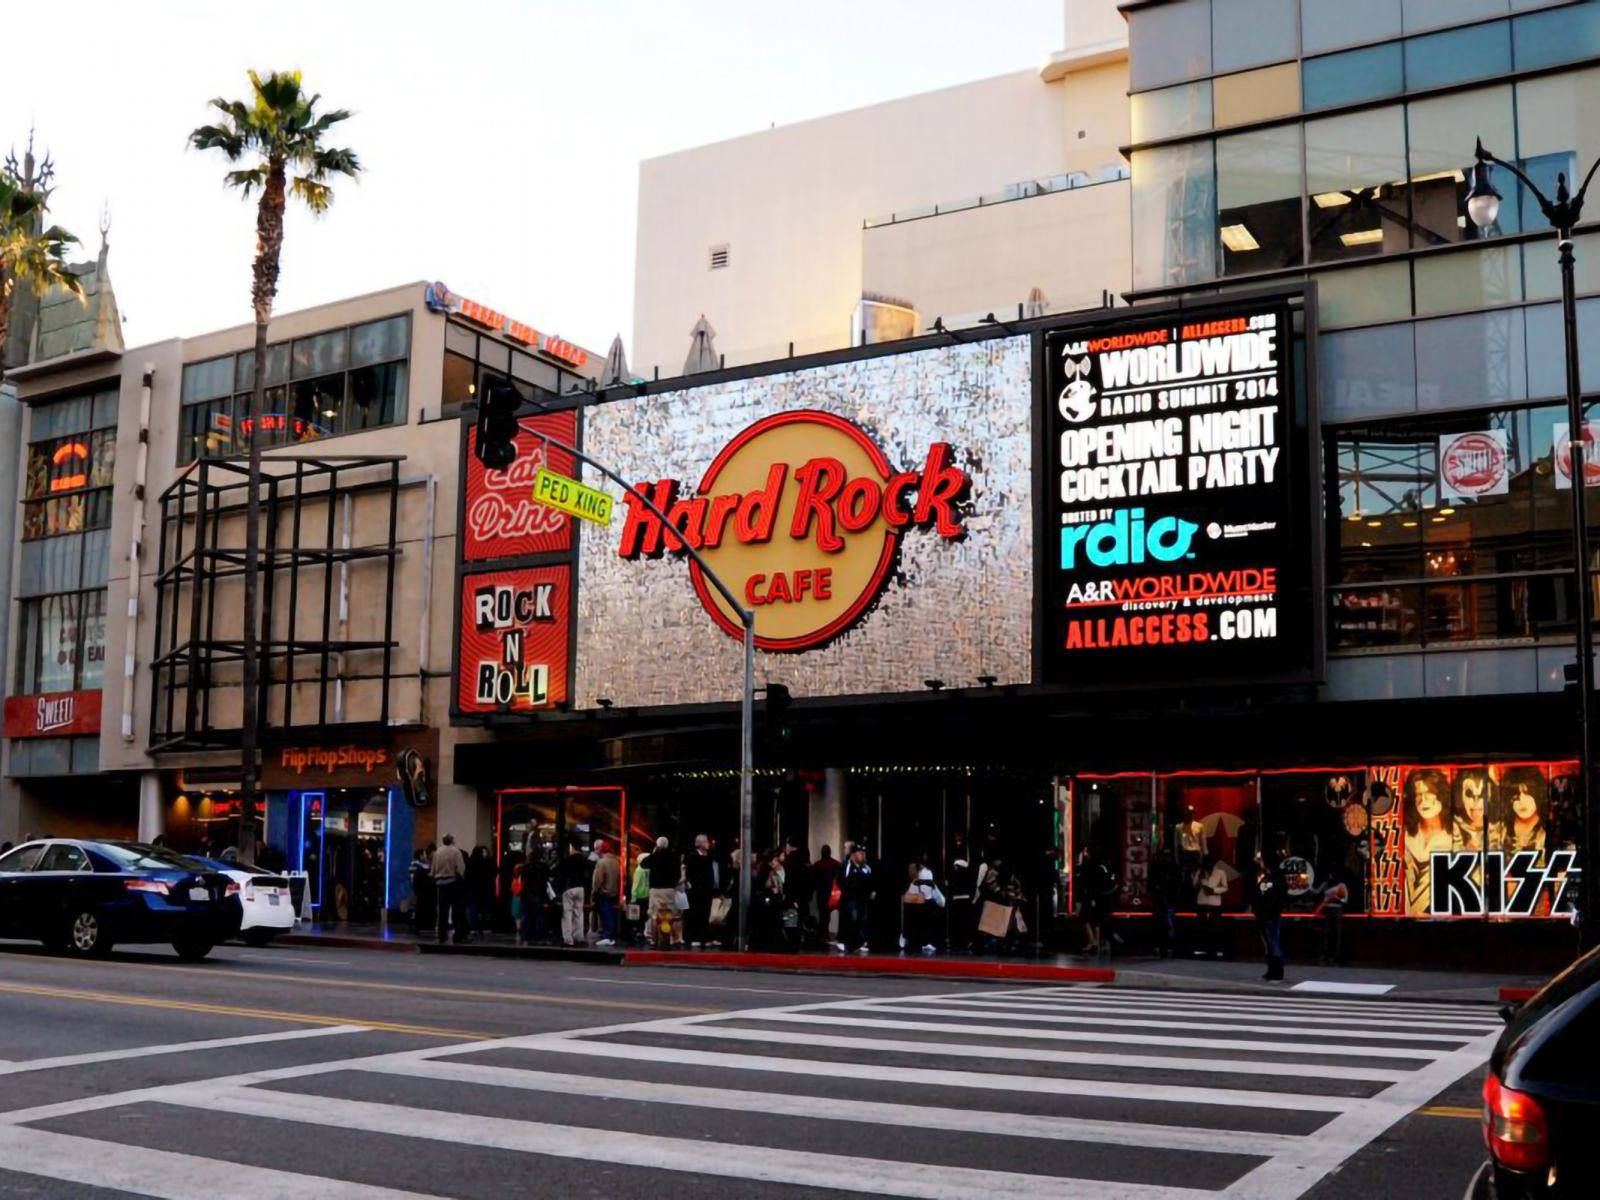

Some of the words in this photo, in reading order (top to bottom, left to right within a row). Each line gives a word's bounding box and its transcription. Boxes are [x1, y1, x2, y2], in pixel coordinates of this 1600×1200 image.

[1100, 329, 1277, 389] WORLDWIDE
[1101, 392, 1151, 417] RADIO
[1158, 383, 1228, 410] SUMMIT
[1235, 377, 1278, 401] 2014
[1061, 418, 1182, 468] OPENING
[1190, 405, 1278, 454] NIGHT
[540, 475, 570, 505] PED
[574, 490, 607, 519] XING
[1061, 458, 1182, 503] COCKTAIL
[1189, 447, 1280, 490] PARTY
[619, 463, 788, 558] Hard
[790, 442, 965, 553] Rock
[1100, 508, 1113, 520] BY
[1061, 507, 1198, 570] rdio
[476, 584, 553, 628] ROCK
[745, 568, 832, 605] CAFE
[1122, 600, 1177, 612] discovery
[1196, 593, 1274, 607] development
[506, 635, 520, 663] N
[1066, 608, 1277, 649] ALLACCESS.COM
[477, 661, 548, 705] ROLL
[1430, 851, 1582, 915] KISS
